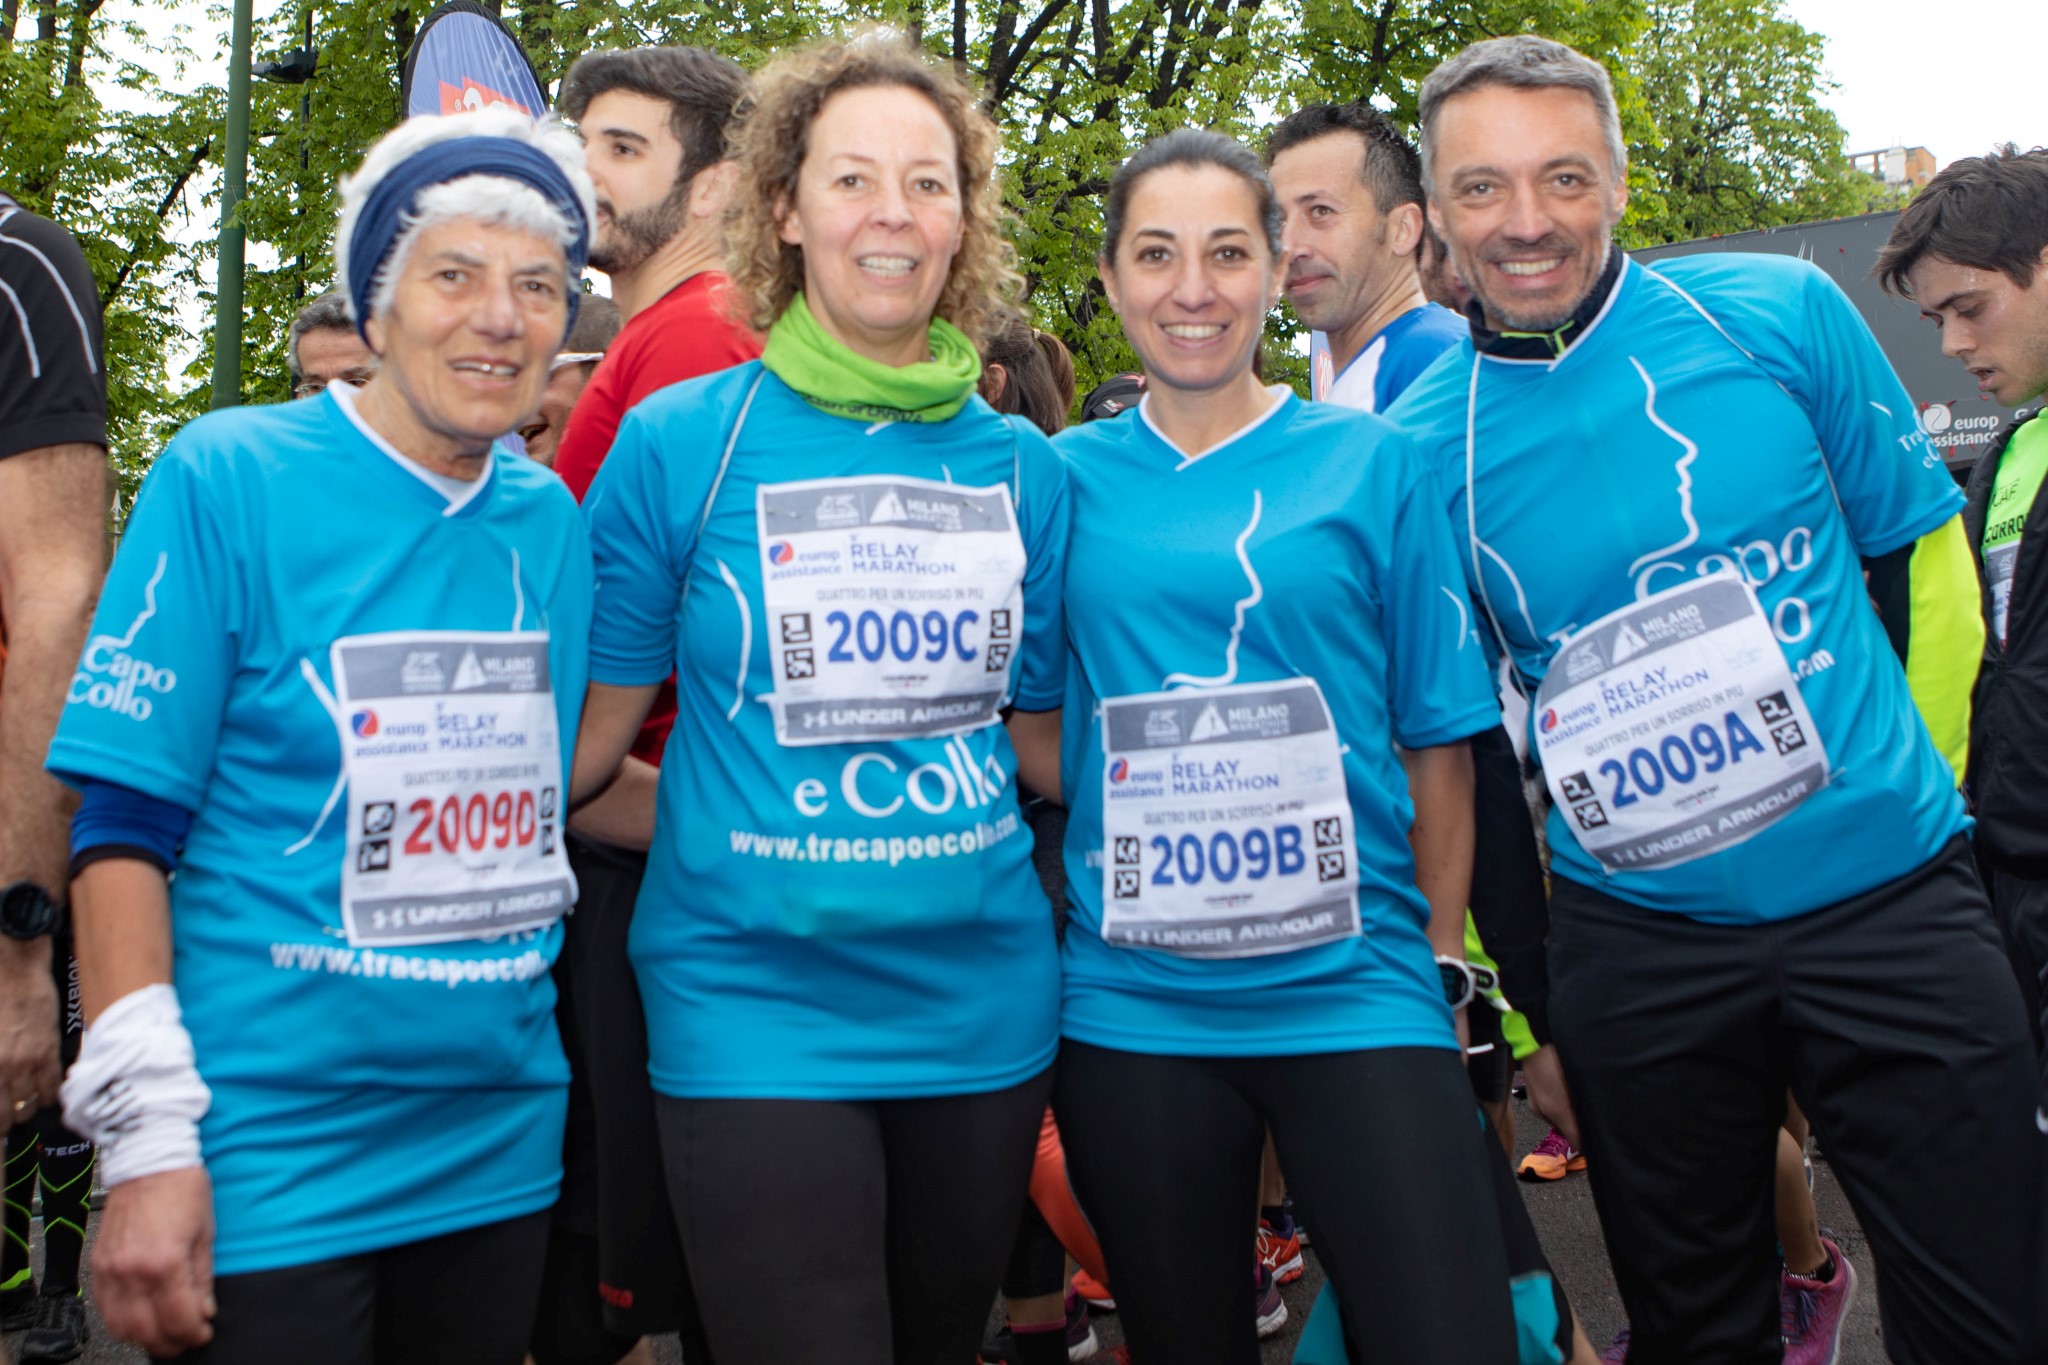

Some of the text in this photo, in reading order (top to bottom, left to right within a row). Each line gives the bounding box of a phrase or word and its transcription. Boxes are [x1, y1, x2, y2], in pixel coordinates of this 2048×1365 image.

[1954, 415, 1999, 430] europ
[1984, 513, 2028, 543] CORRO
[799, 550, 841, 563] europ
[851, 542, 919, 559] RELAY
[770, 564, 842, 581] assistance
[852, 560, 956, 576] MARATHON
[816, 588, 867, 601] QUATTRO
[1641, 604, 1700, 636] MILANO
[825, 609, 980, 663] 2009C
[84, 634, 177, 694] Capo
[66, 671, 153, 722] Collo
[1601, 666, 1668, 705] RELAY
[1607, 668, 1710, 718] MARATHON
[436, 713, 498, 733] RELAY
[831, 700, 983, 726] UNDER ARMOUR
[1228, 703, 1289, 721] MILANO
[1561, 702, 1597, 723] europ
[1543, 715, 1602, 749] assistance
[1584, 726, 1630, 757] QUATTRO
[1630, 719, 1650, 737] PER
[1651, 714, 1667, 730] UN
[1667, 697, 1714, 724] SORRISO
[1172, 760, 1240, 780] RELAY
[1598, 710, 1766, 810] 2009A
[793, 734, 1007, 819] e Collo
[1130, 770, 1164, 784] europ
[1172, 774, 1280, 796] MARATHON
[1109, 785, 1165, 799] assistance
[403, 790, 536, 856] 2009D
[1144, 810, 1186, 825] QUATTRO
[1188, 808, 1207, 823] PER
[1210, 806, 1224, 821] UN
[1640, 824, 1714, 858] UNDER
[1718, 779, 1808, 833] ARMOUR
[1150, 824, 1306, 886] 2009B
[408, 900, 493, 926] UNDER
[1152, 911, 1335, 945] UNDER ARMOUR
[44, 1140, 92, 1157] TECH
